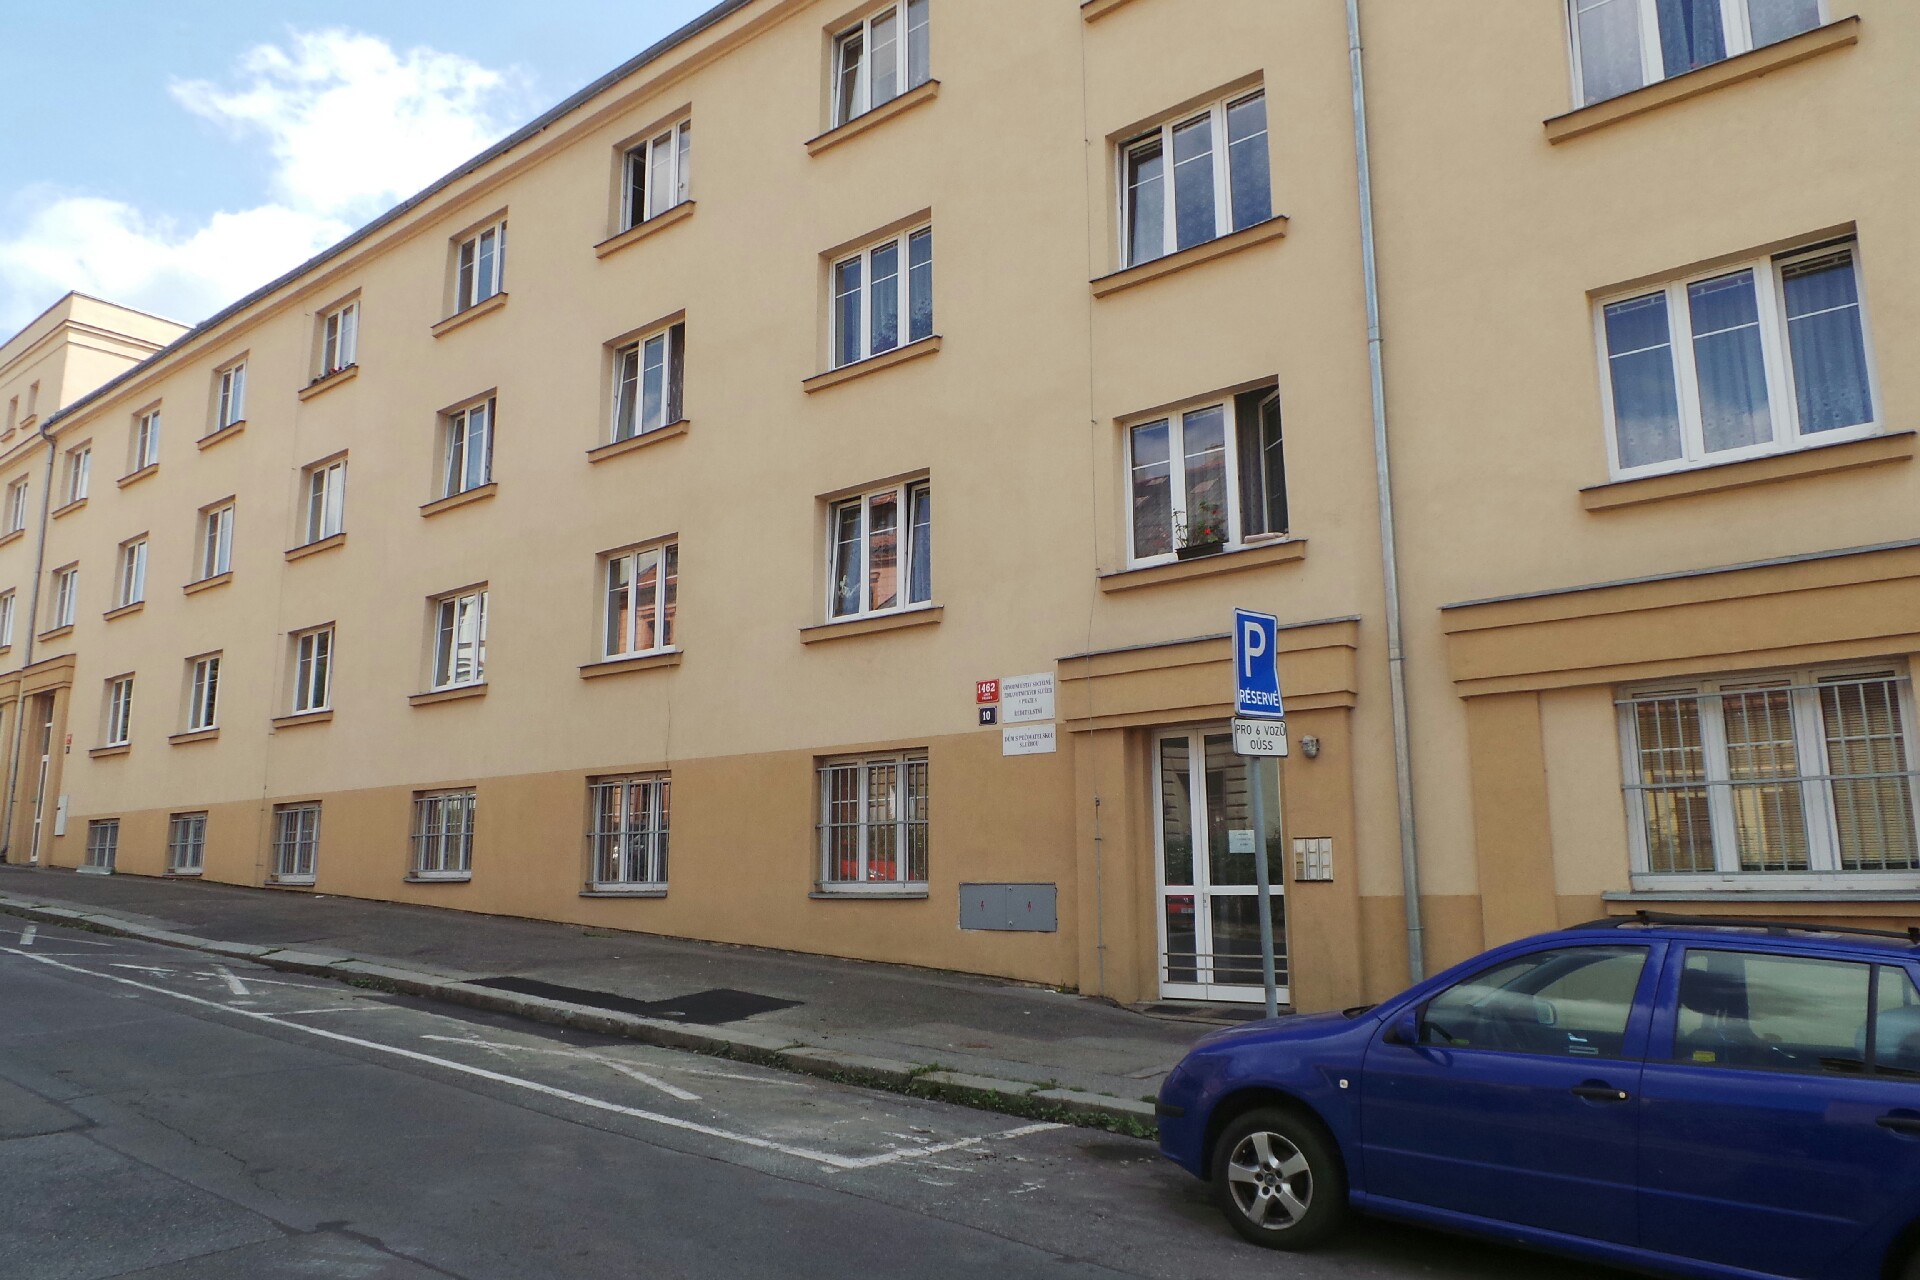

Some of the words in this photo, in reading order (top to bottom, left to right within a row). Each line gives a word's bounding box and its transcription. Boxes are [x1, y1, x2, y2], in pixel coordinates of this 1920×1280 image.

[1244, 621, 1266, 678] P
[977, 682, 996, 694] 1462
[1239, 687, 1280, 706] RÉSERVÉ
[982, 710, 991, 721] 10
[1236, 724, 1252, 735] PRO
[1255, 725, 1261, 736] 6
[1264, 723, 1286, 736] VOZŮ
